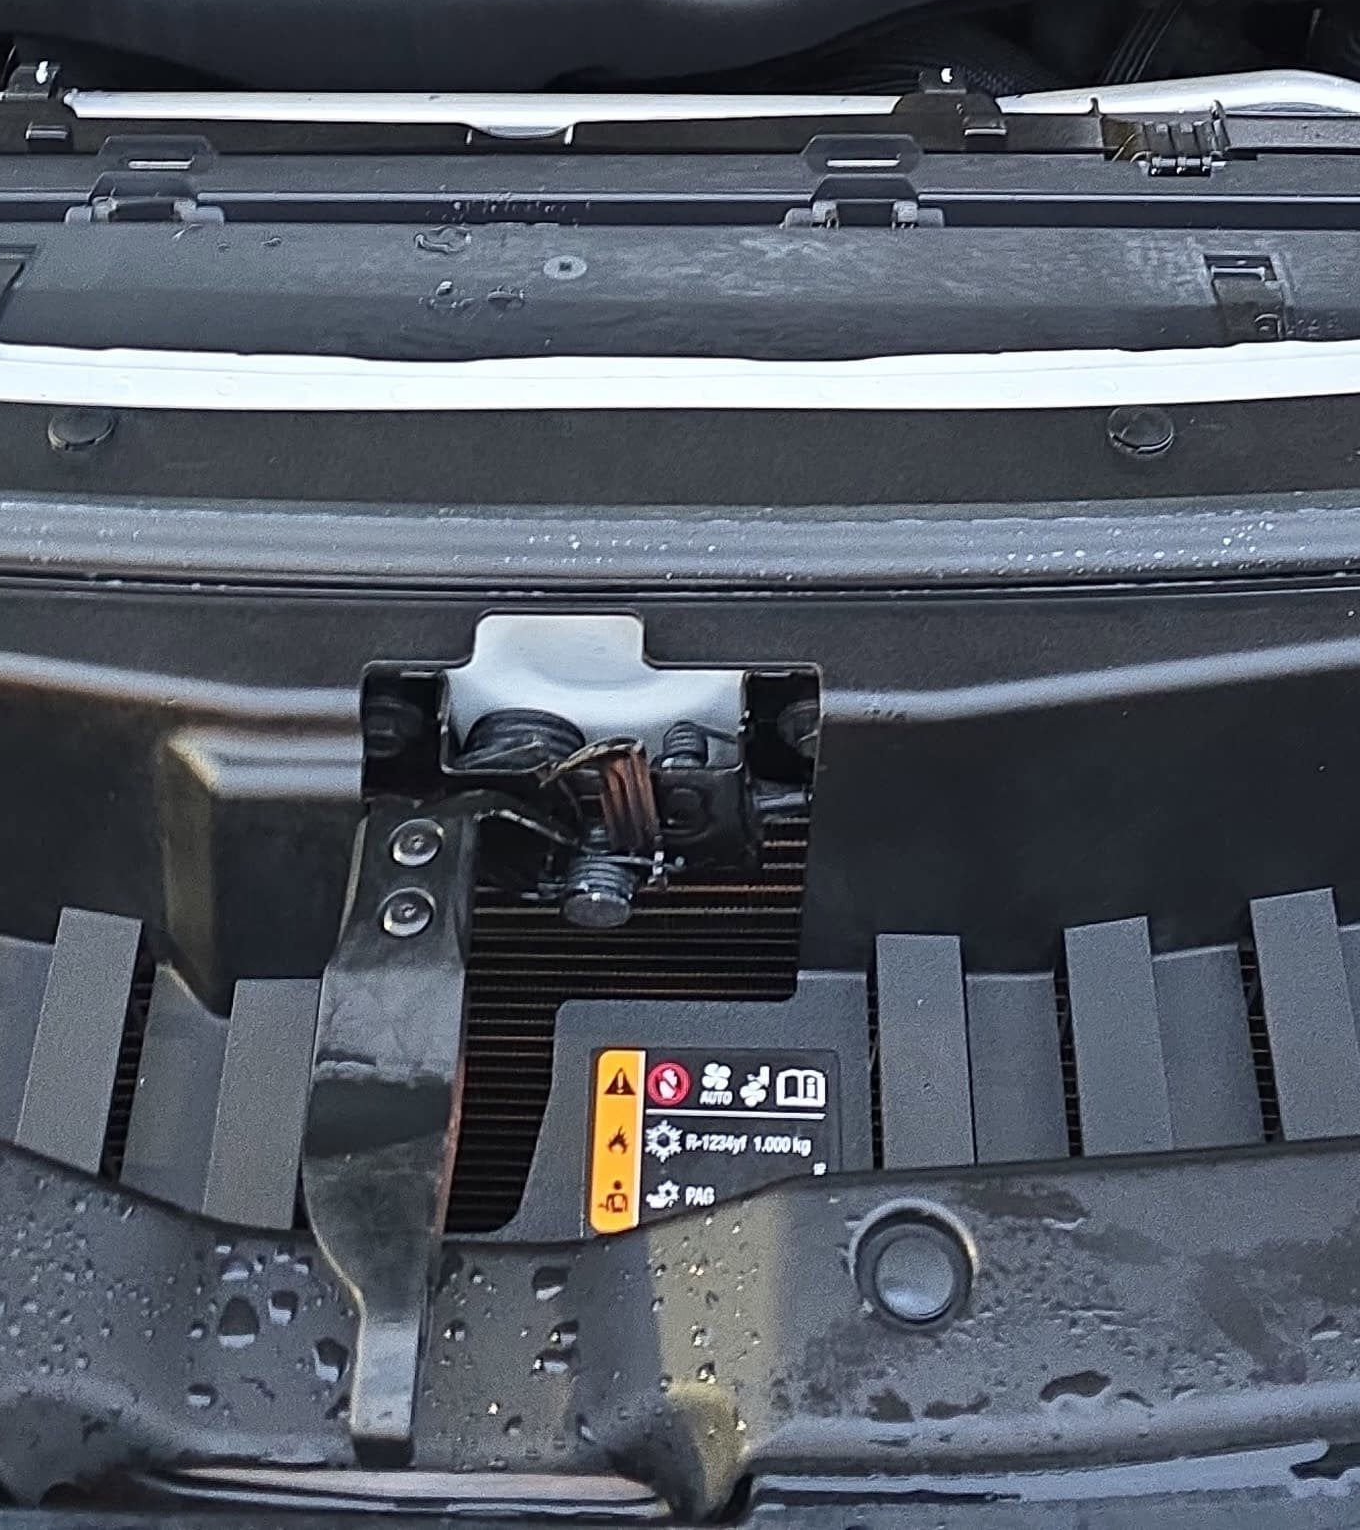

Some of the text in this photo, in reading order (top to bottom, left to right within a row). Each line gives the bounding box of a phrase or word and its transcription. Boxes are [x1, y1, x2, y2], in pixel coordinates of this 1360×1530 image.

[699, 1090, 733, 1105] AUTO
[686, 1133, 811, 1157] R-1234yf 1.000 kg
[685, 1186, 715, 1206] PAG
